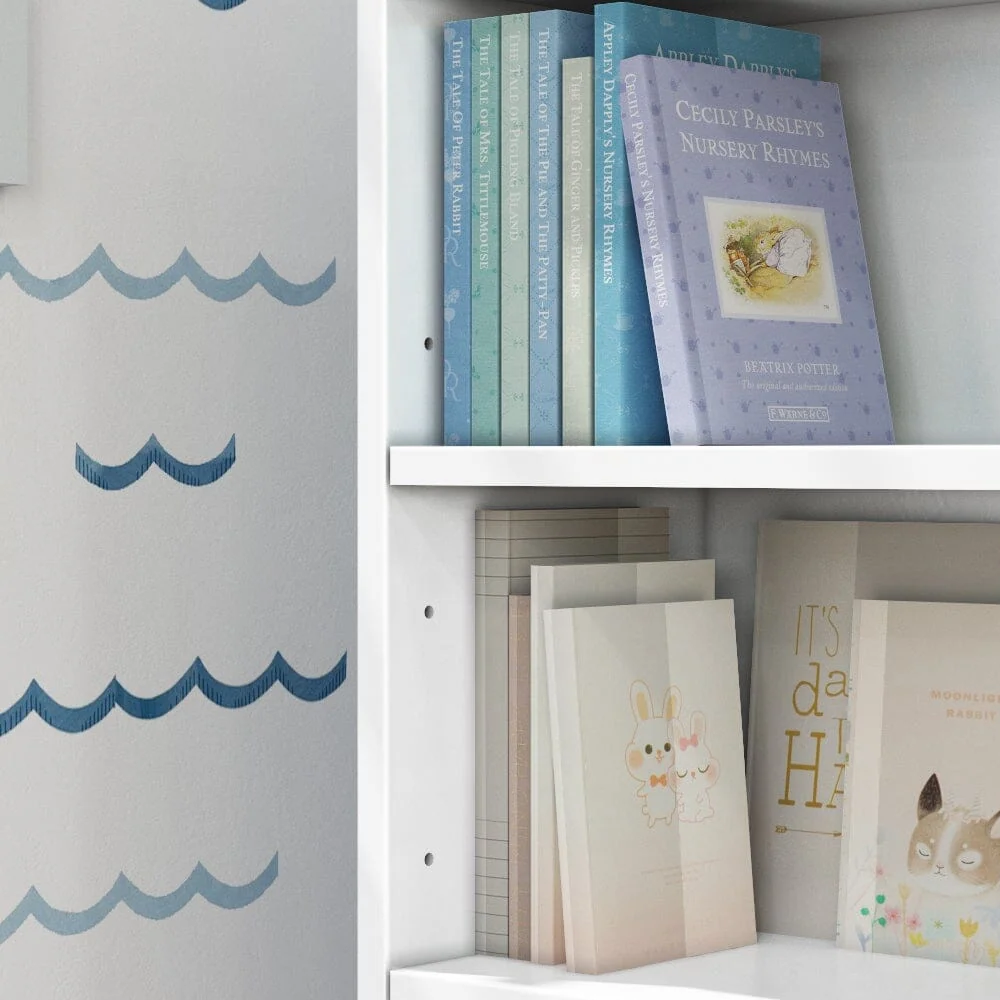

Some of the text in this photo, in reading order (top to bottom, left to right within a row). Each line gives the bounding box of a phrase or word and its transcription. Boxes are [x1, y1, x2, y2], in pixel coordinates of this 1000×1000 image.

[453, 37, 464, 68] THE
[480, 34, 491, 65] THE
[453, 71, 464, 107] TALE
[480, 68, 491, 105] TALE
[453, 111, 464, 130] OF
[480, 108, 491, 128] OF
[675, 100, 825, 138] CECILY PARSLEY'S
[603, 21, 616, 284] APPLEY DAPPLY'S NURSERY RHYMES
[680, 131, 830, 169] NURSERY RHYMES
[539, 28, 550, 340] THE TALE OF THE PIE AND THE PATTY-PAN
[624, 73, 669, 308] CECILY PARSLEY'S NURSERY RHYMES
[453, 184, 464, 237] RABBIT
[743, 360, 840, 376] BEATRIX POTTER
[795, 605, 839, 658] IT'S
[946, 708, 997, 721] RABBIT
